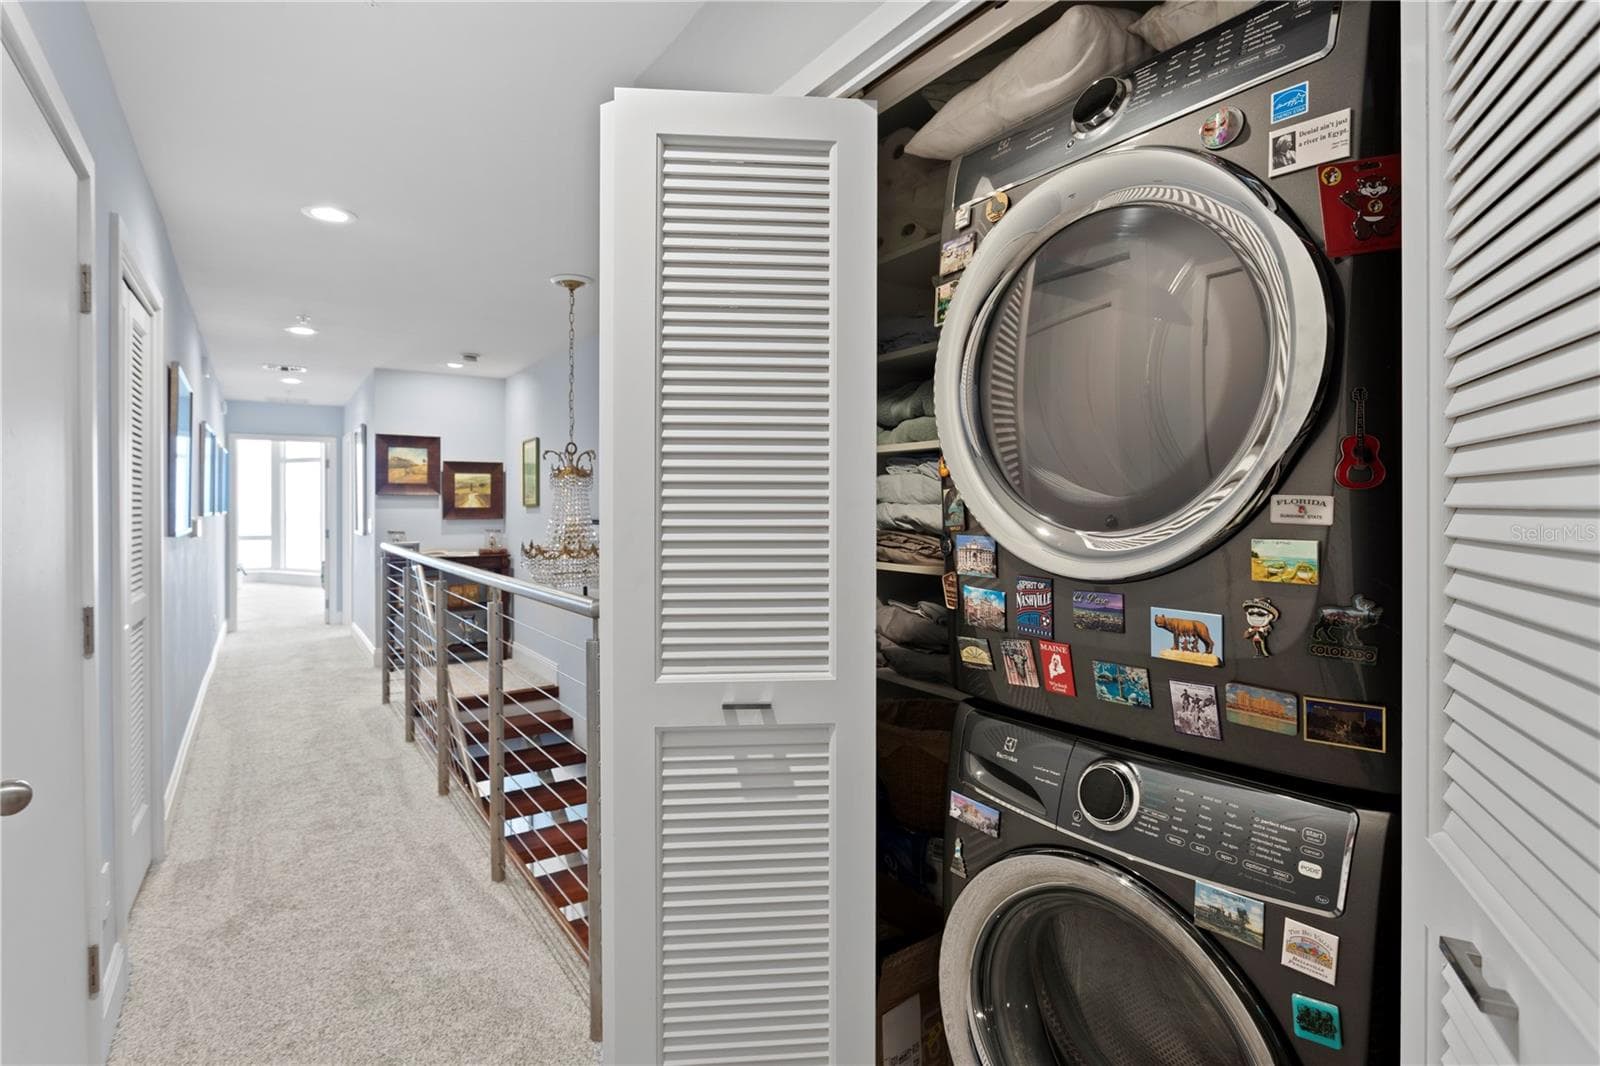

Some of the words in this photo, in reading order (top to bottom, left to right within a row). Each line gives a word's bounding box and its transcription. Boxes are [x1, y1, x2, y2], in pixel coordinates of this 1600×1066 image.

[1299, 126, 1319, 138] Denial
[1320, 121, 1335, 131] ain't
[1336, 118, 1348, 128] just
[1303, 136, 1319, 146] river
[1320, 133, 1327, 141] in
[1328, 128, 1349, 140] Egypt.
[1276, 499, 1327, 508] FLORIDA
[1016, 580, 1037, 590] SPIRIT
[1015, 592, 1052, 608] NASHVILLE
[1040, 643, 1069, 654] MAINE
[1311, 646, 1376, 661] COLORADO
